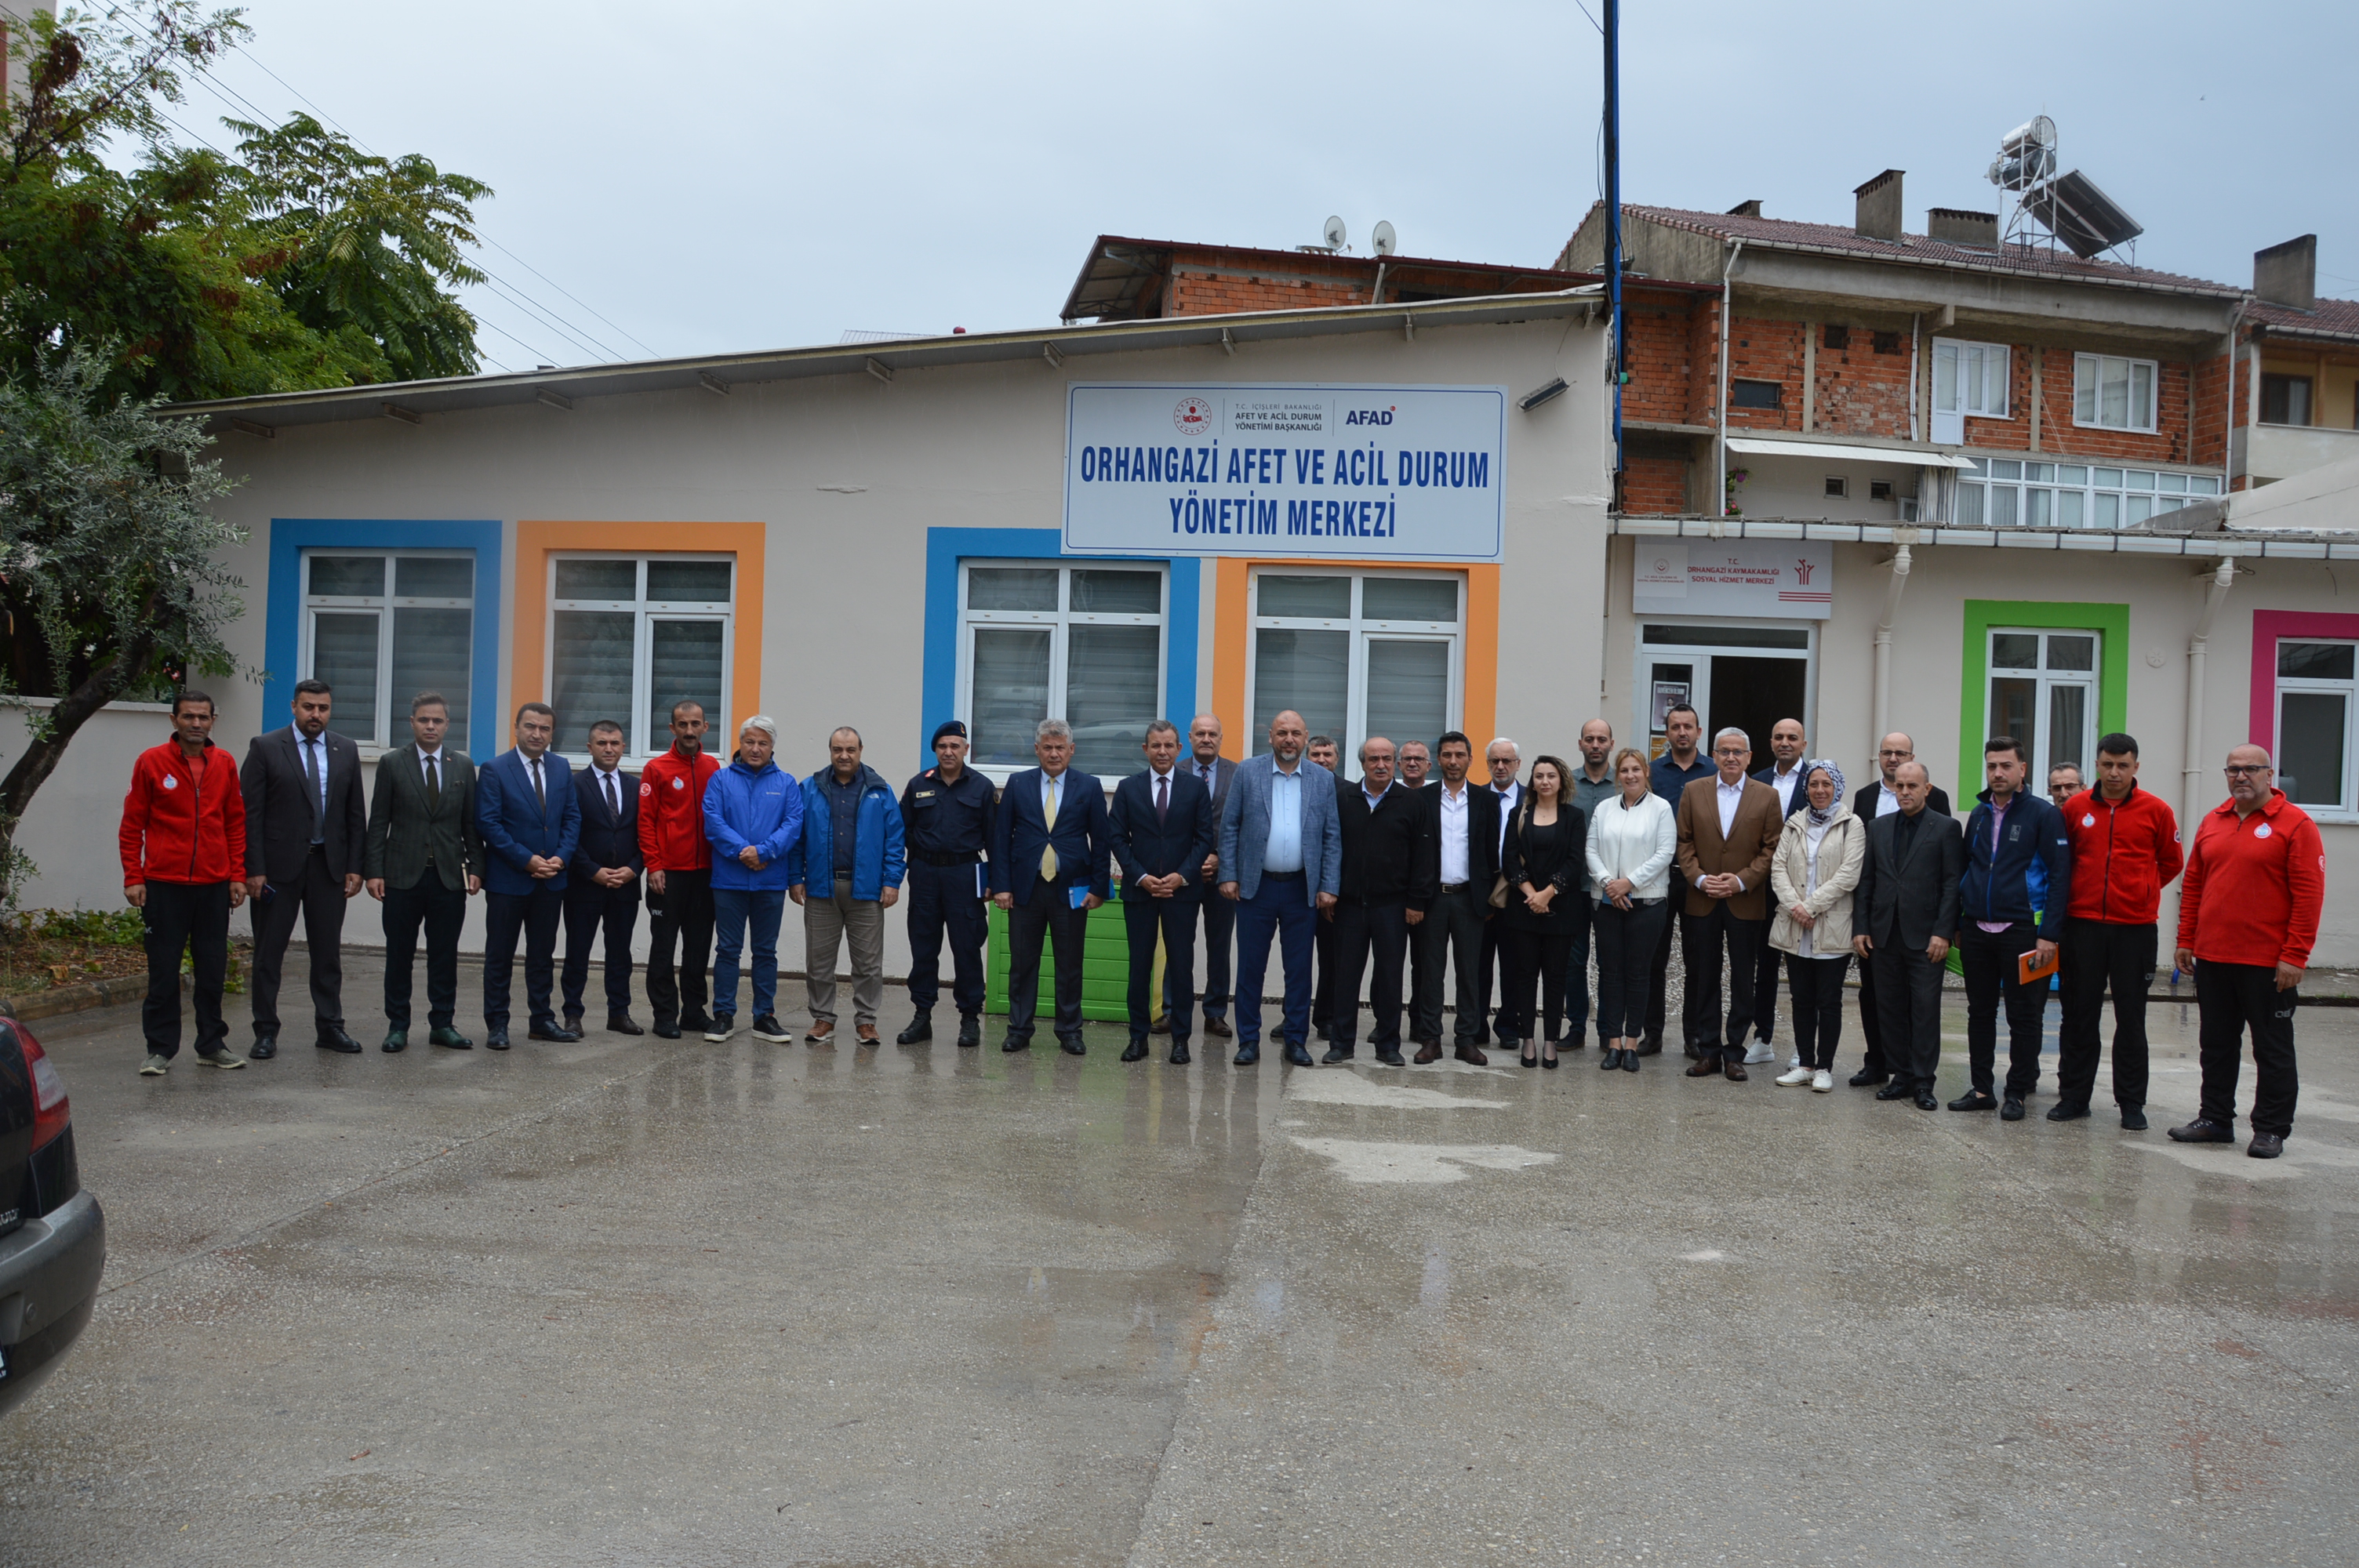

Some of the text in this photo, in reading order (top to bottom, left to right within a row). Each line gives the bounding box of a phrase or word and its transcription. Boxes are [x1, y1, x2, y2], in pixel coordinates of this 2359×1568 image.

[1270, 412, 1289, 420] ACİL
[1291, 412, 1321, 421] DURUM
[1346, 410, 1393, 426] AFAD
[1235, 422, 1322, 432] YÖNETİMİ BAŞKANLIĞI
[1081, 438, 1488, 488] ORHANGAZİ AFET VE ACİL DURUM
[1169, 489, 1395, 537] YÖNETİM MERKEZİ
[1728, 567, 1779, 575] KAYMAKAMLIĞI
